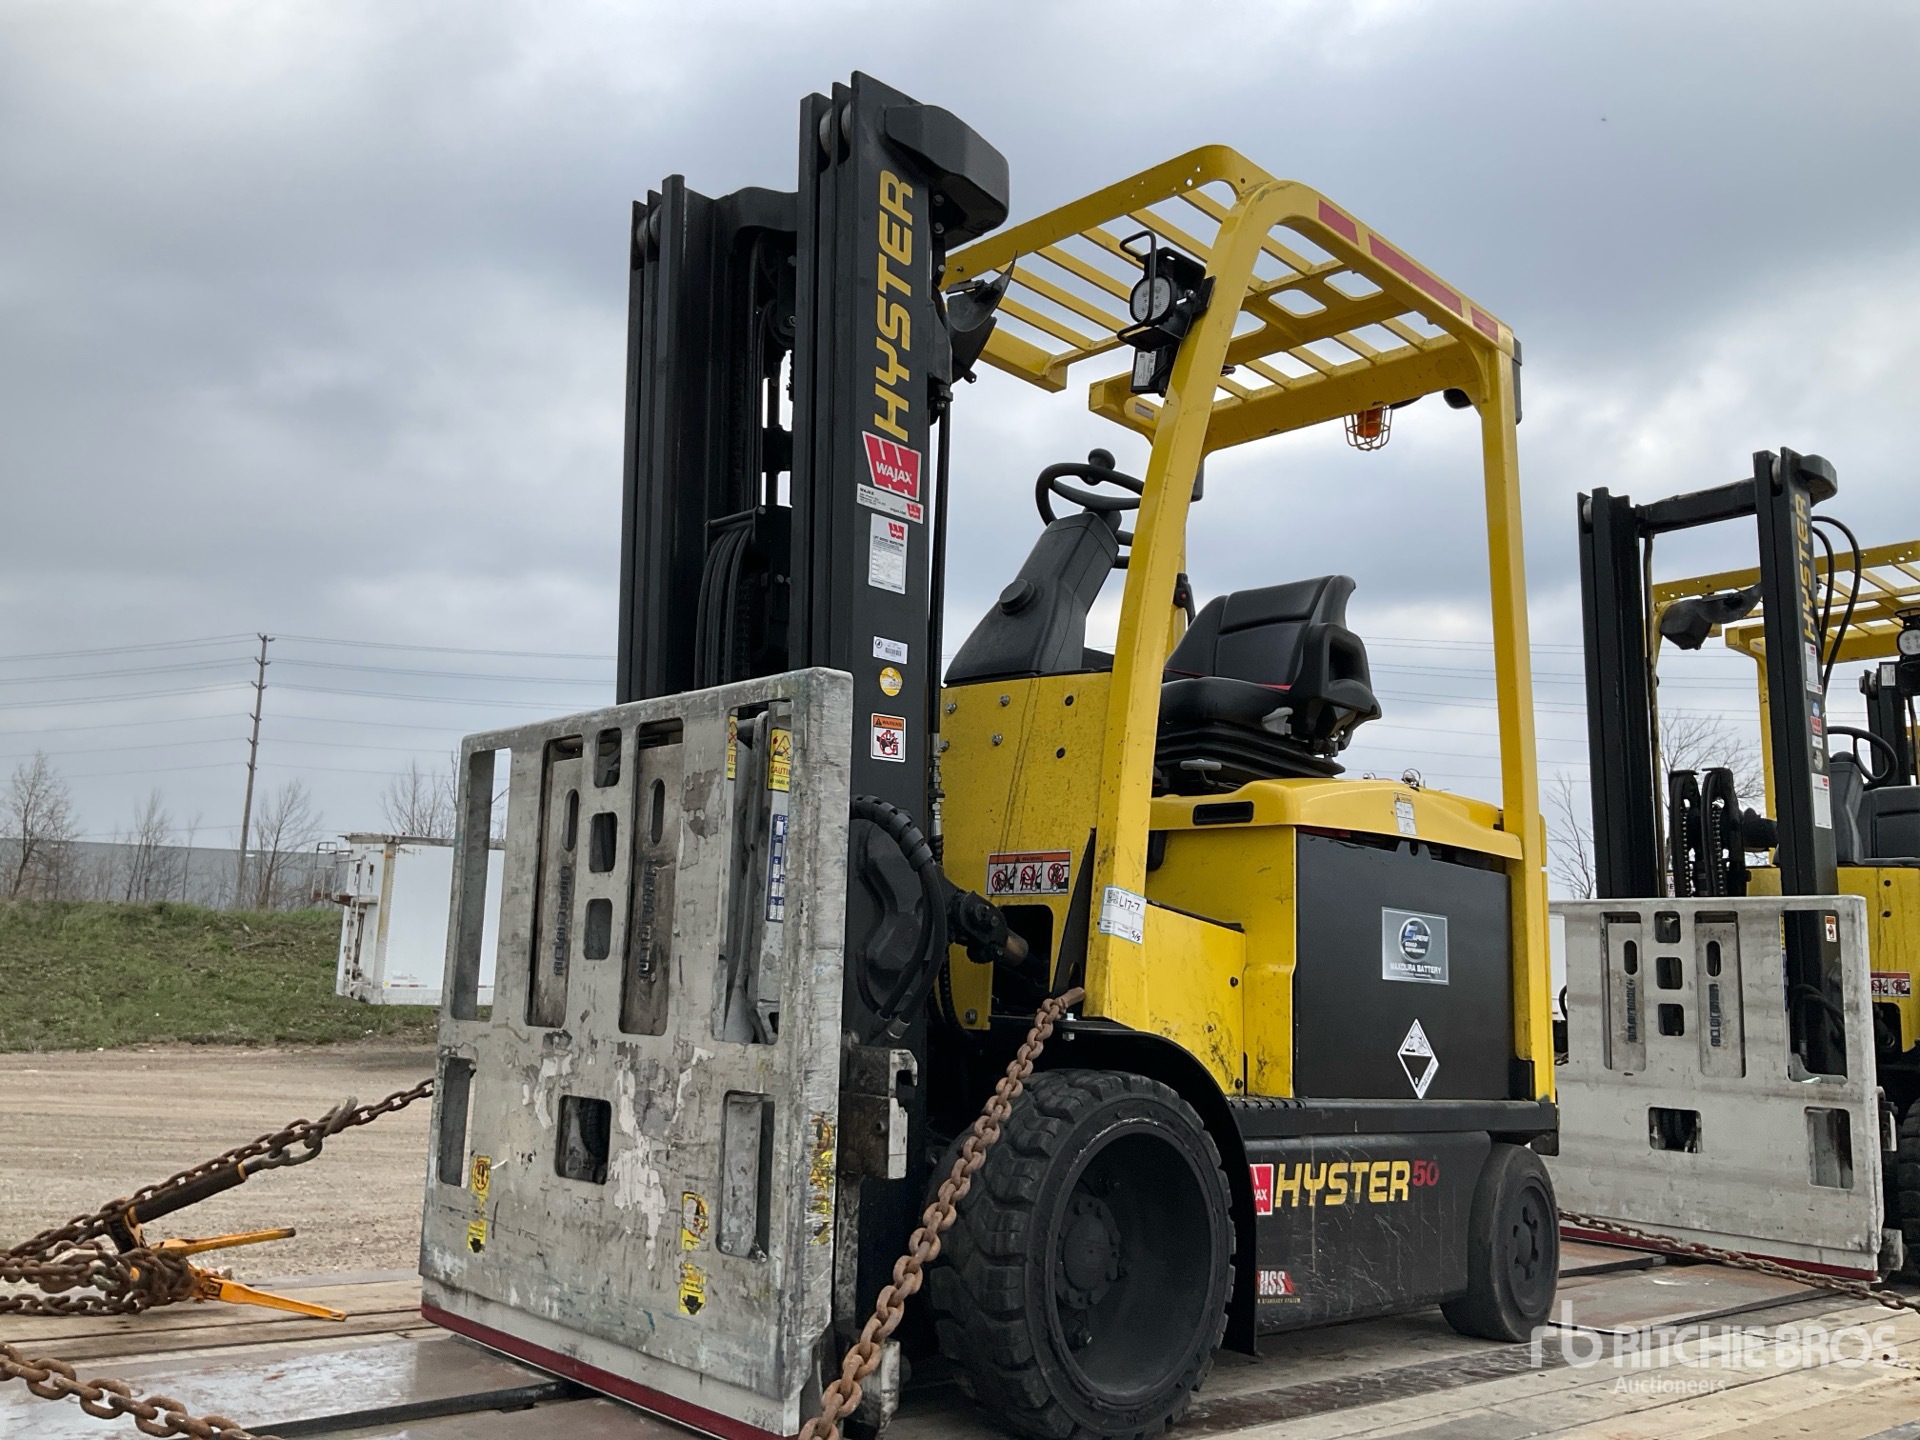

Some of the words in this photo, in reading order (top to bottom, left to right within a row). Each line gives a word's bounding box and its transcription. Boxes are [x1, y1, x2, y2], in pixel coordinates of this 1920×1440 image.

[873, 169, 914, 443] HYSTER
[875, 461, 913, 485] WAJAX
[1794, 492, 1816, 642] HYSTER
[882, 720, 903, 728] WARNING
[770, 765, 791, 776] CAUTI
[1118, 895, 1141, 912] L17-7
[1416, 965, 1442, 975] BATTERY
[1273, 1160, 1412, 1208] HYSTER
[1412, 1159, 1440, 1187] 50
[1259, 1270, 1286, 1295] HSS
